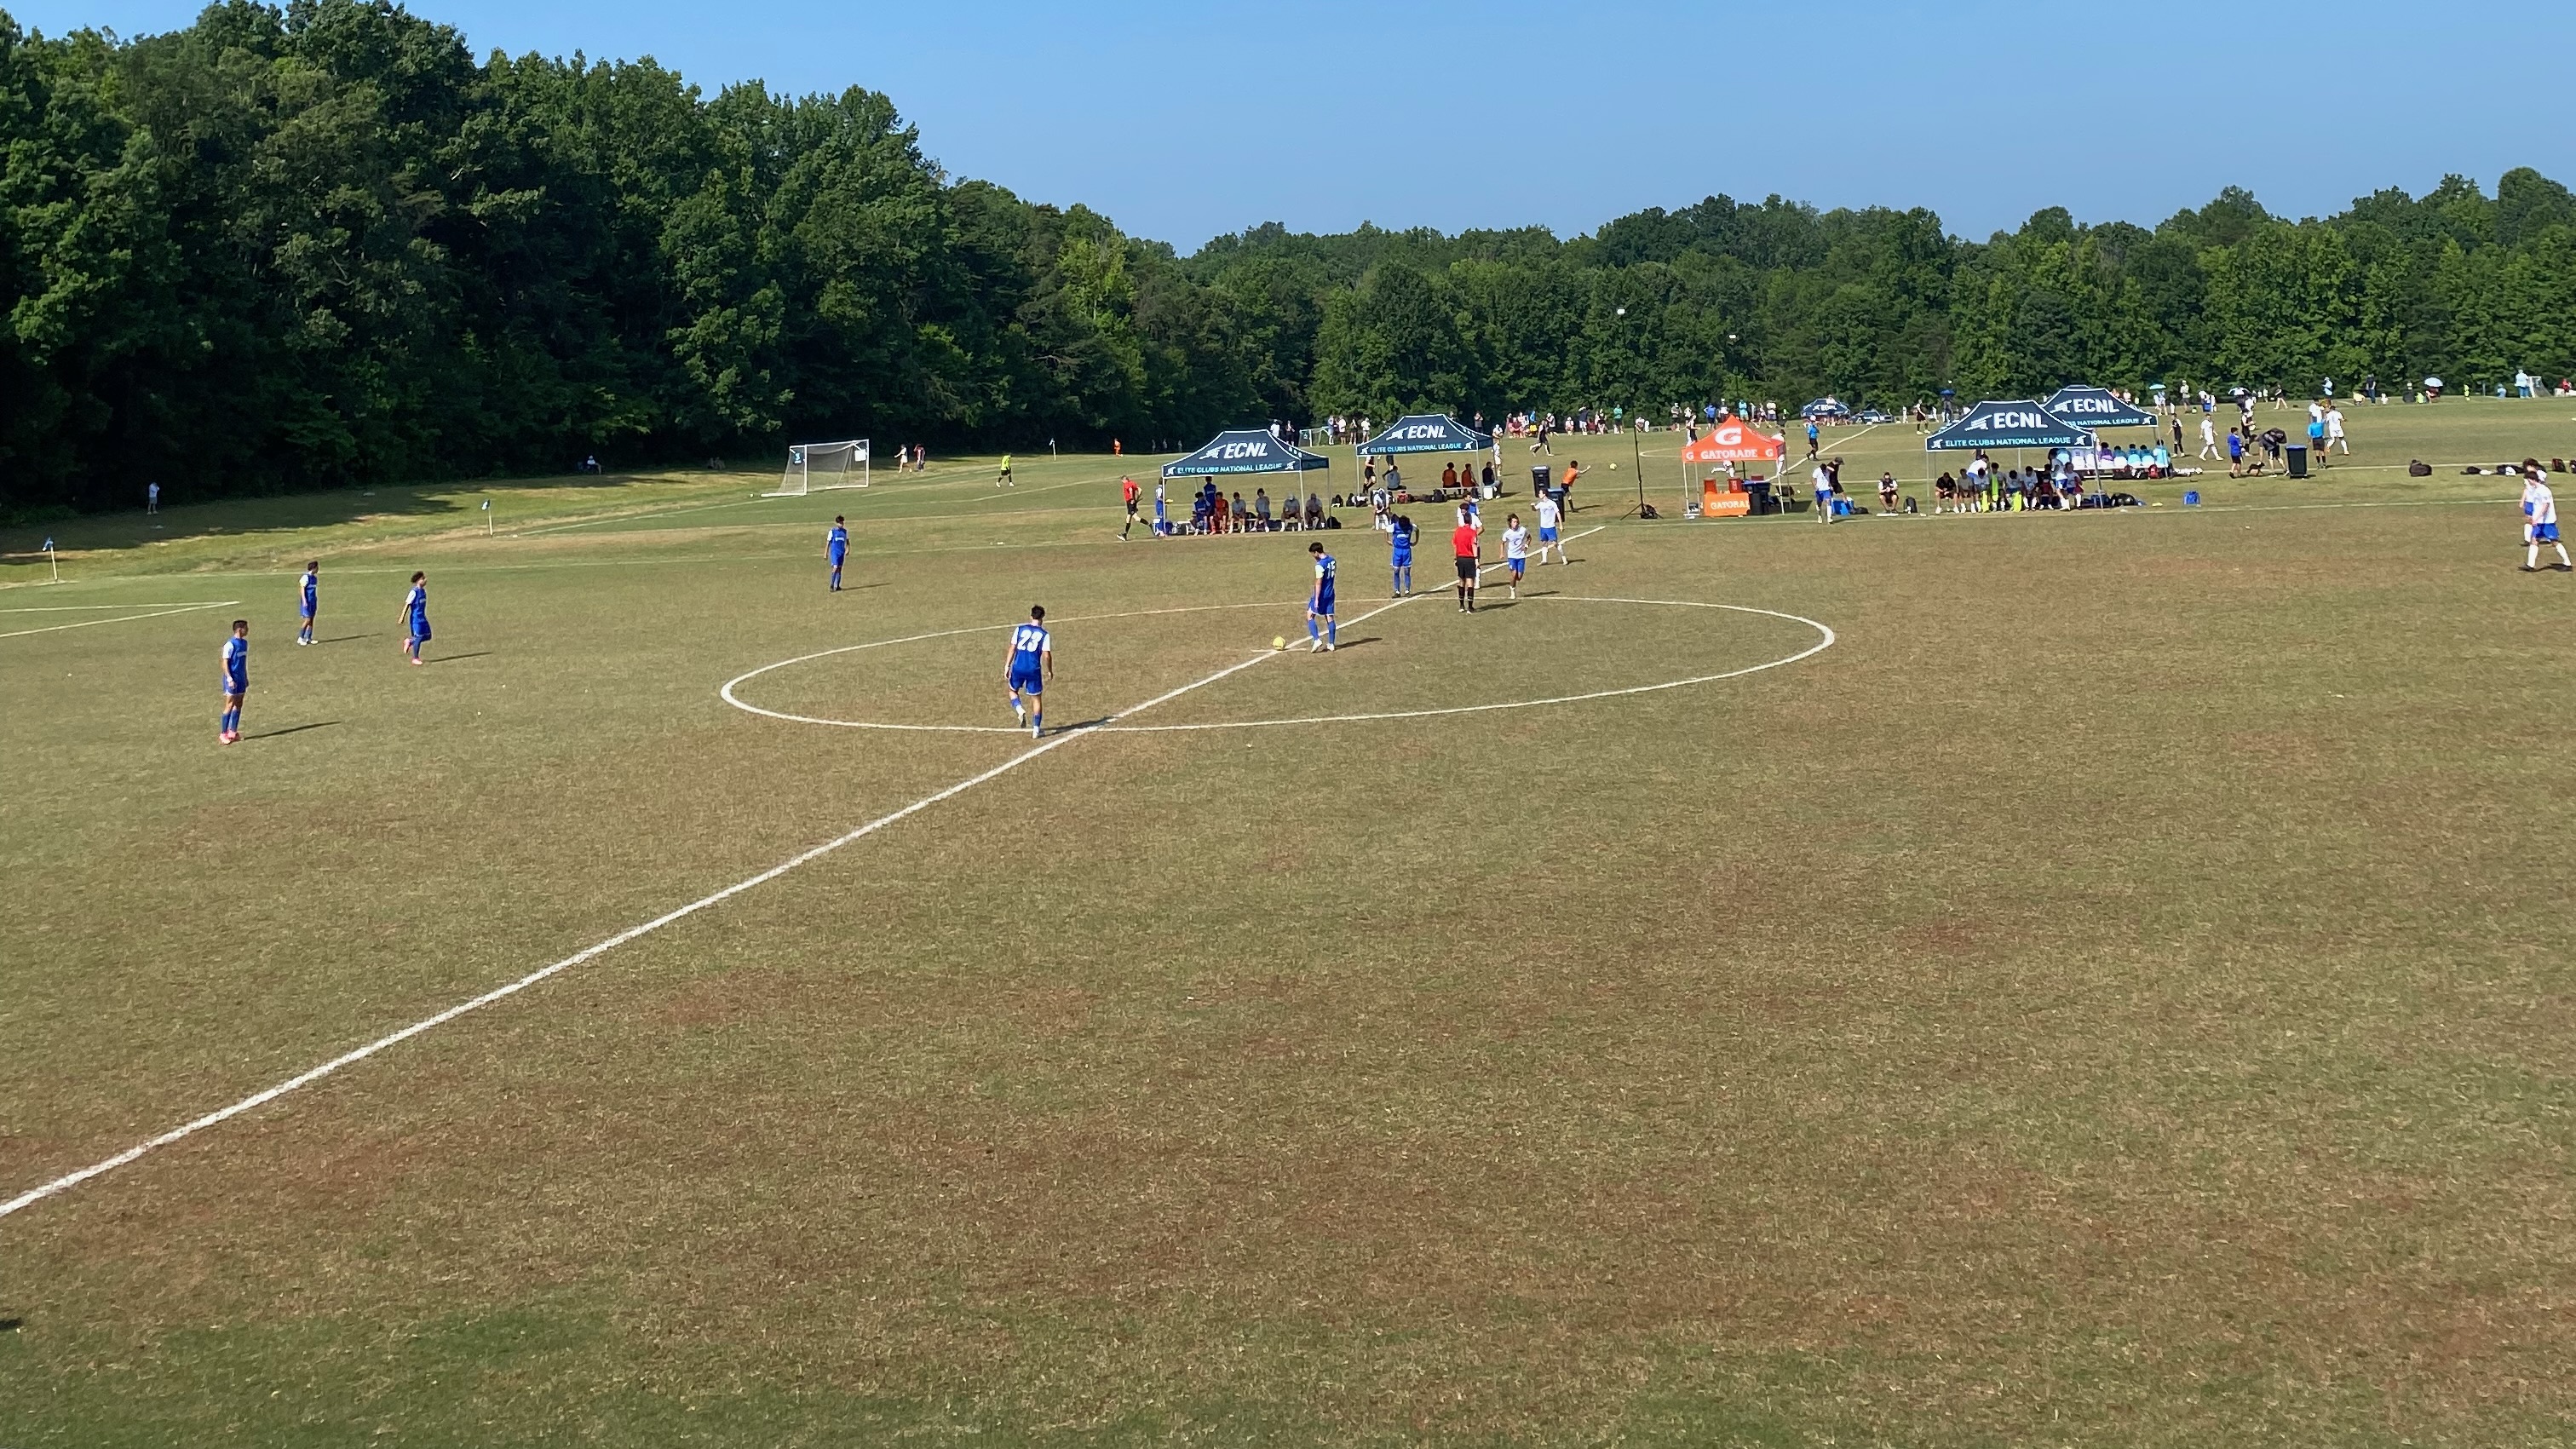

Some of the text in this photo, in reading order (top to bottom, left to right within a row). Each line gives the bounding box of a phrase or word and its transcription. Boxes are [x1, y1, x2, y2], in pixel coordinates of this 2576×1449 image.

[2073, 398, 2120, 413] ECNL
[1993, 412, 2048, 428] ECNL
[1407, 425, 1447, 439] ECNL
[1715, 428, 1742, 445] G
[1945, 436, 2071, 447] ELITE CLUBS NATIONAL LEAGUE
[1223, 442, 1268, 459] ECNL
[1700, 449, 1758, 459] GATORADE
[1017, 630, 1044, 653] 23
